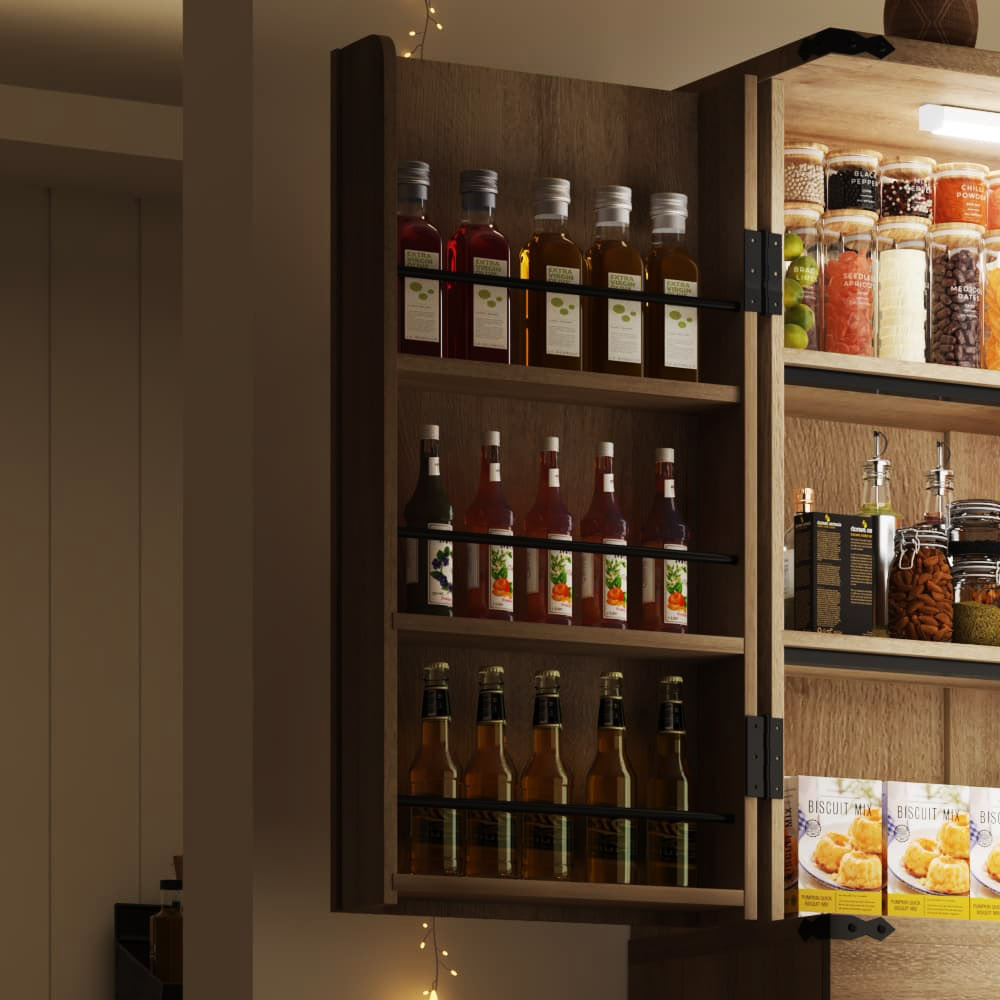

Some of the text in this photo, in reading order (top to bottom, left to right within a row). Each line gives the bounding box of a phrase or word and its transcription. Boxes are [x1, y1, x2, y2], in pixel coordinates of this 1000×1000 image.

[808, 800, 873, 817] BISCUIT MIX
[897, 805, 960, 822] BISCUIT MIX
